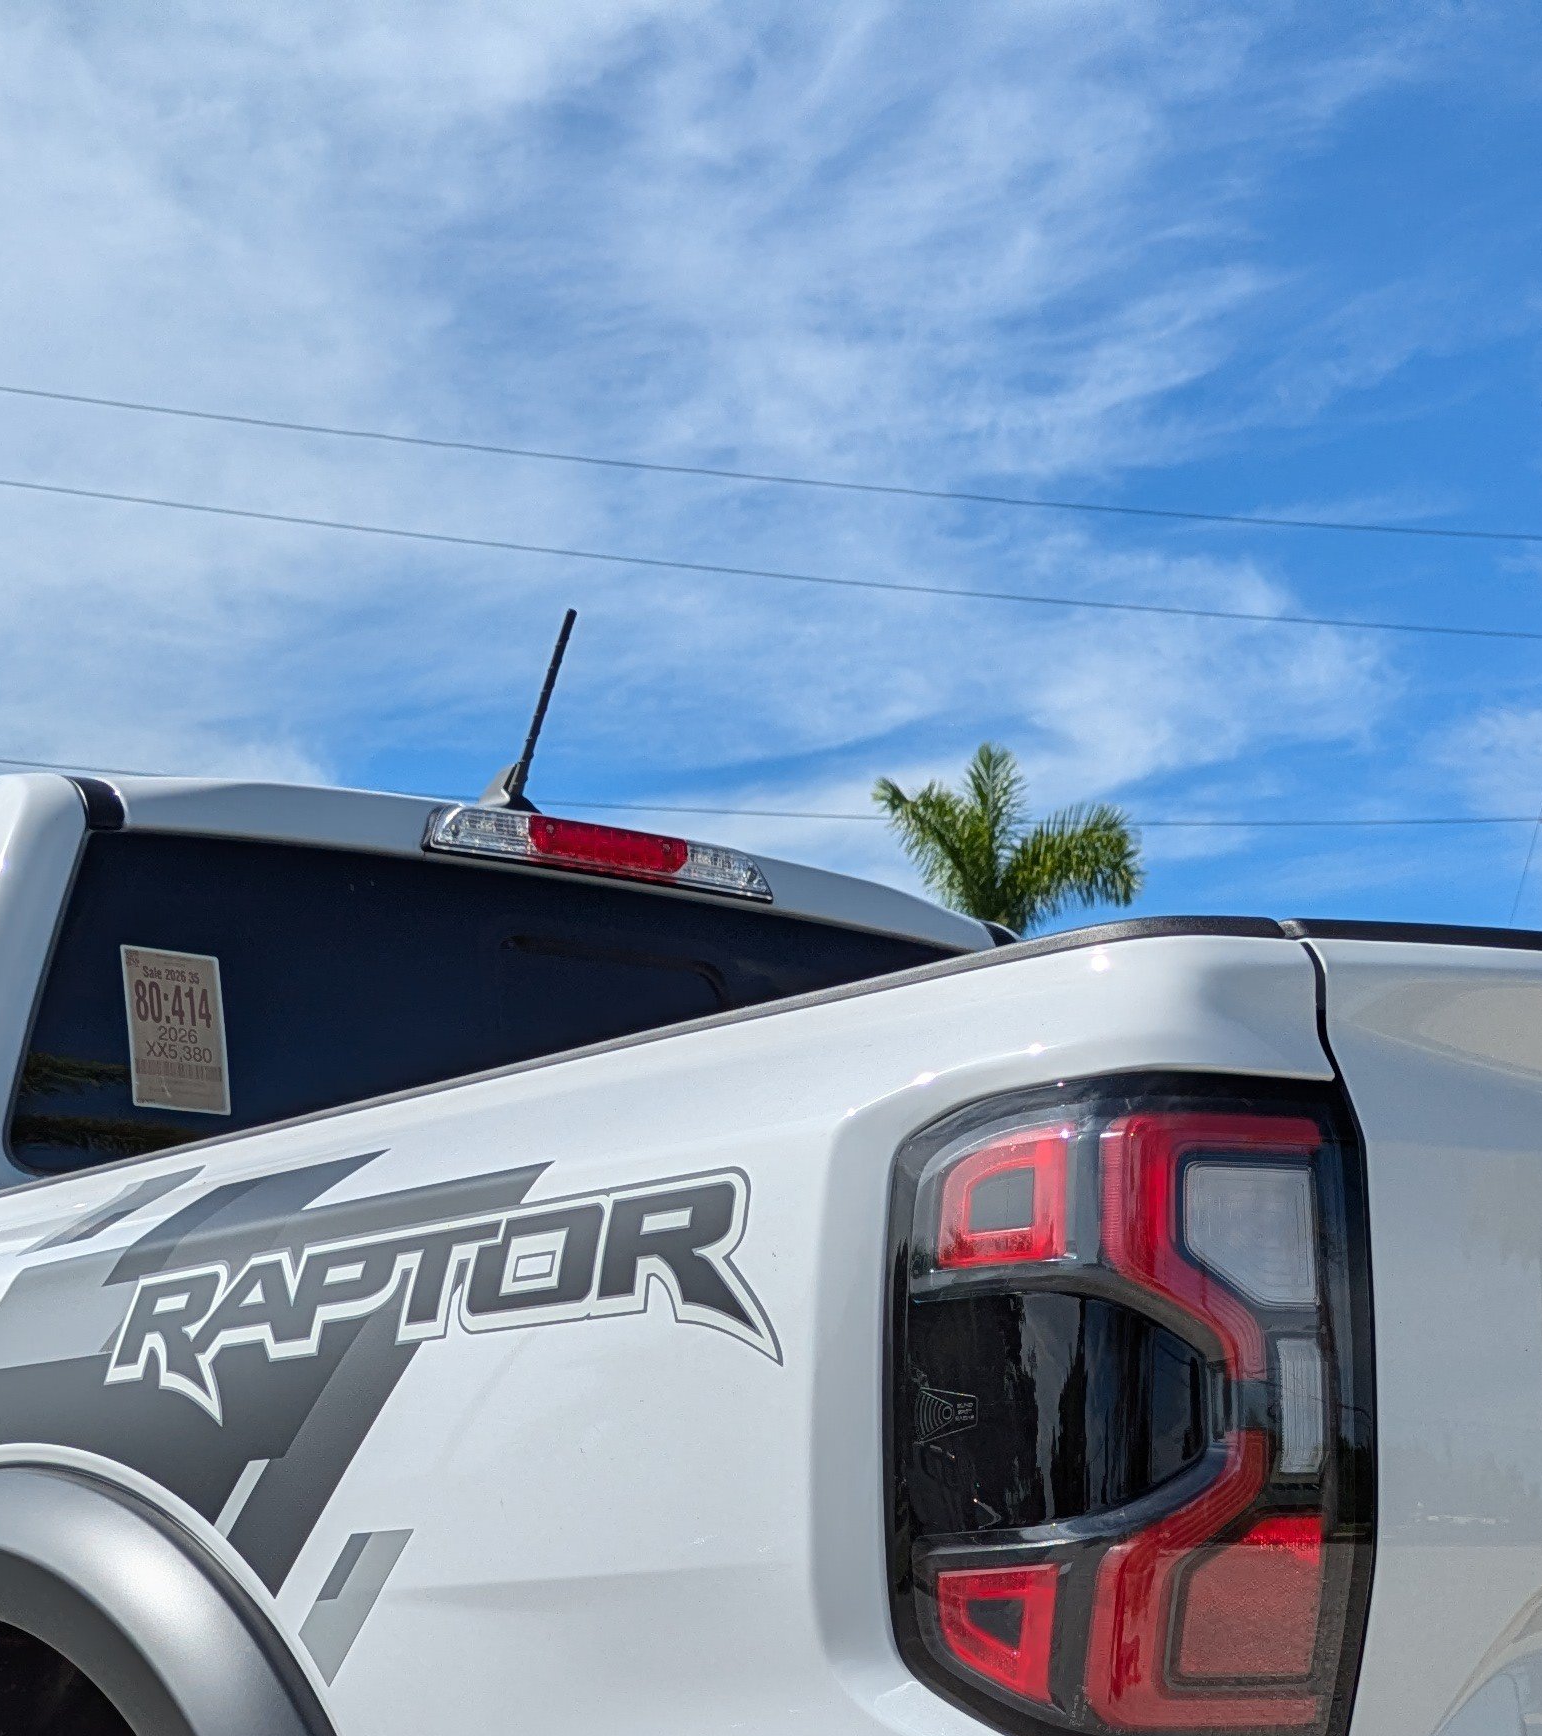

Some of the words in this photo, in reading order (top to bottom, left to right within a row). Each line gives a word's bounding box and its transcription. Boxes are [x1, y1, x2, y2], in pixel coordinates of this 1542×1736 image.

[142, 965, 162, 980] Sale
[158, 1025, 198, 1045] 2026
[104, 1166, 784, 1427] RAPTOR
